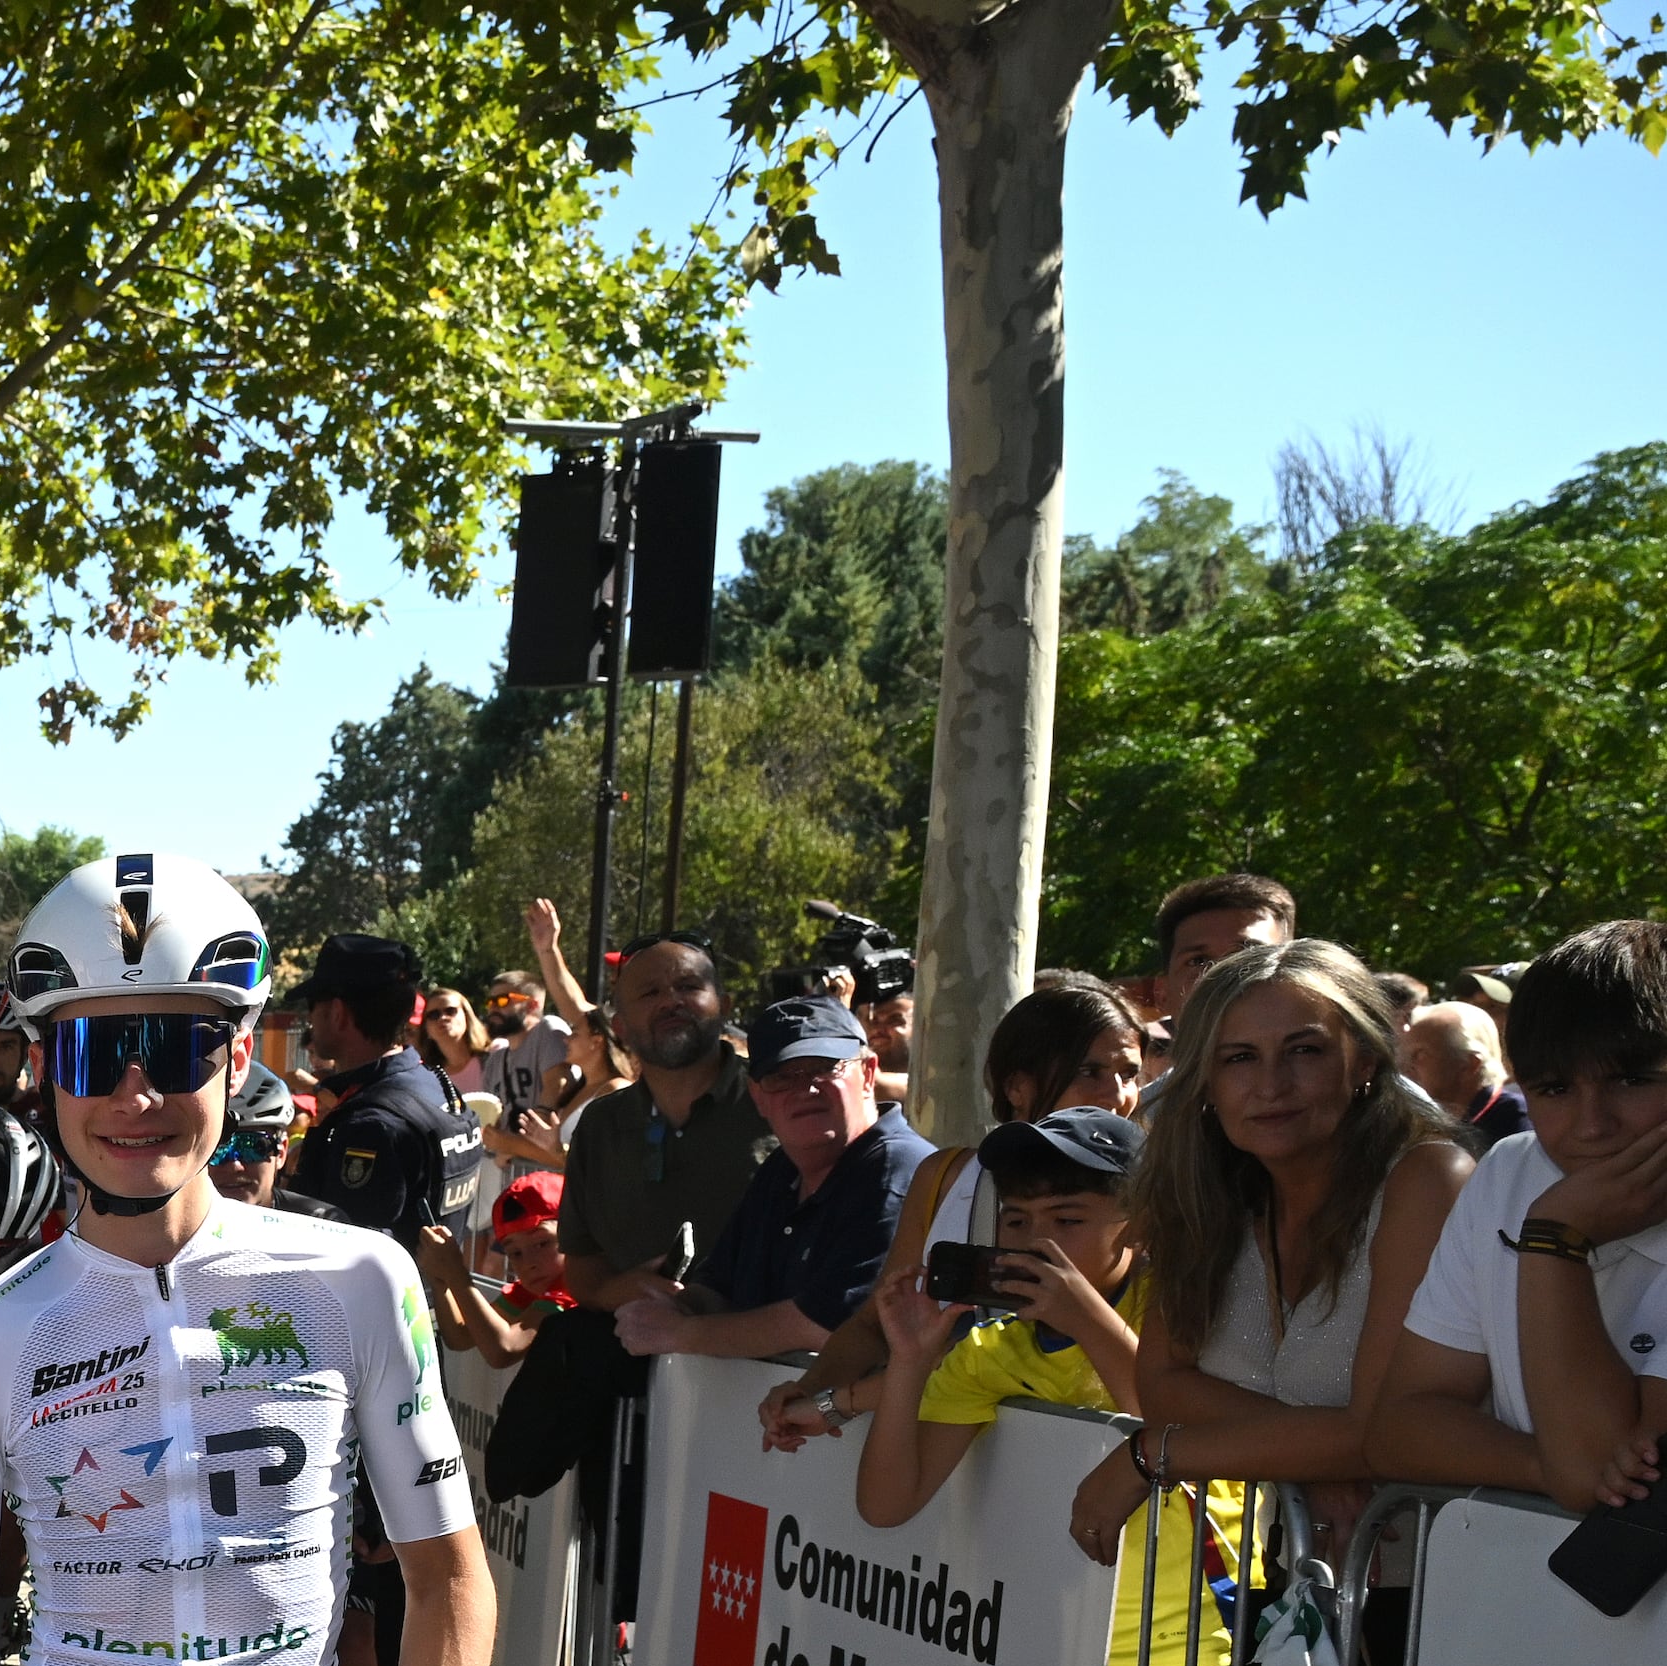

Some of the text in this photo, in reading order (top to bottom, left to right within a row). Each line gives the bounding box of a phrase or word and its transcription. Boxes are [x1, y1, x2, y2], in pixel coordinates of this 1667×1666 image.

[31, 1336, 151, 1399] Santini
[121, 1371, 146, 1391] 25
[53, 1560, 122, 1575] FACTOR
[773, 1513, 1005, 1666] Comunidad
